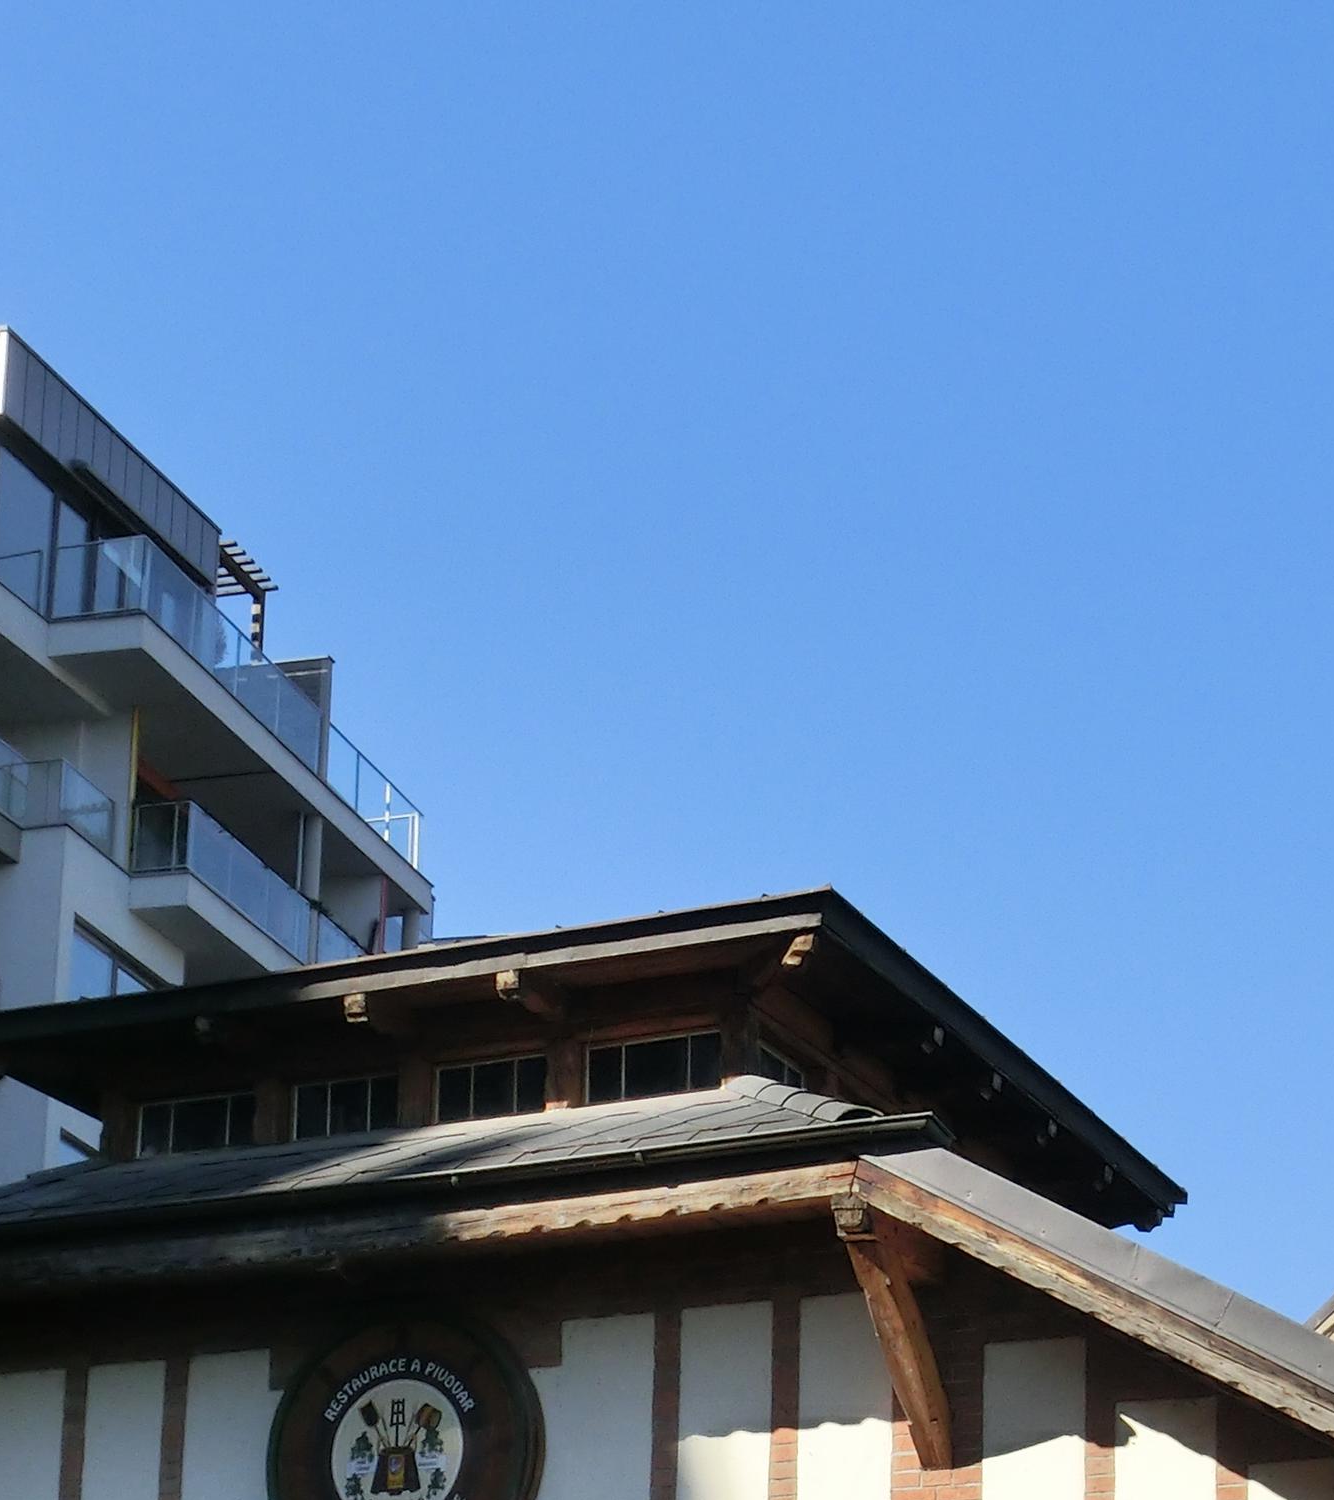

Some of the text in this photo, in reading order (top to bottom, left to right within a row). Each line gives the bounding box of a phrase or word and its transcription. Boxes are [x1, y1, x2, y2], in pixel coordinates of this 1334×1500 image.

[323, 1358, 477, 1423] RESTAURACE A PIVOVAR
